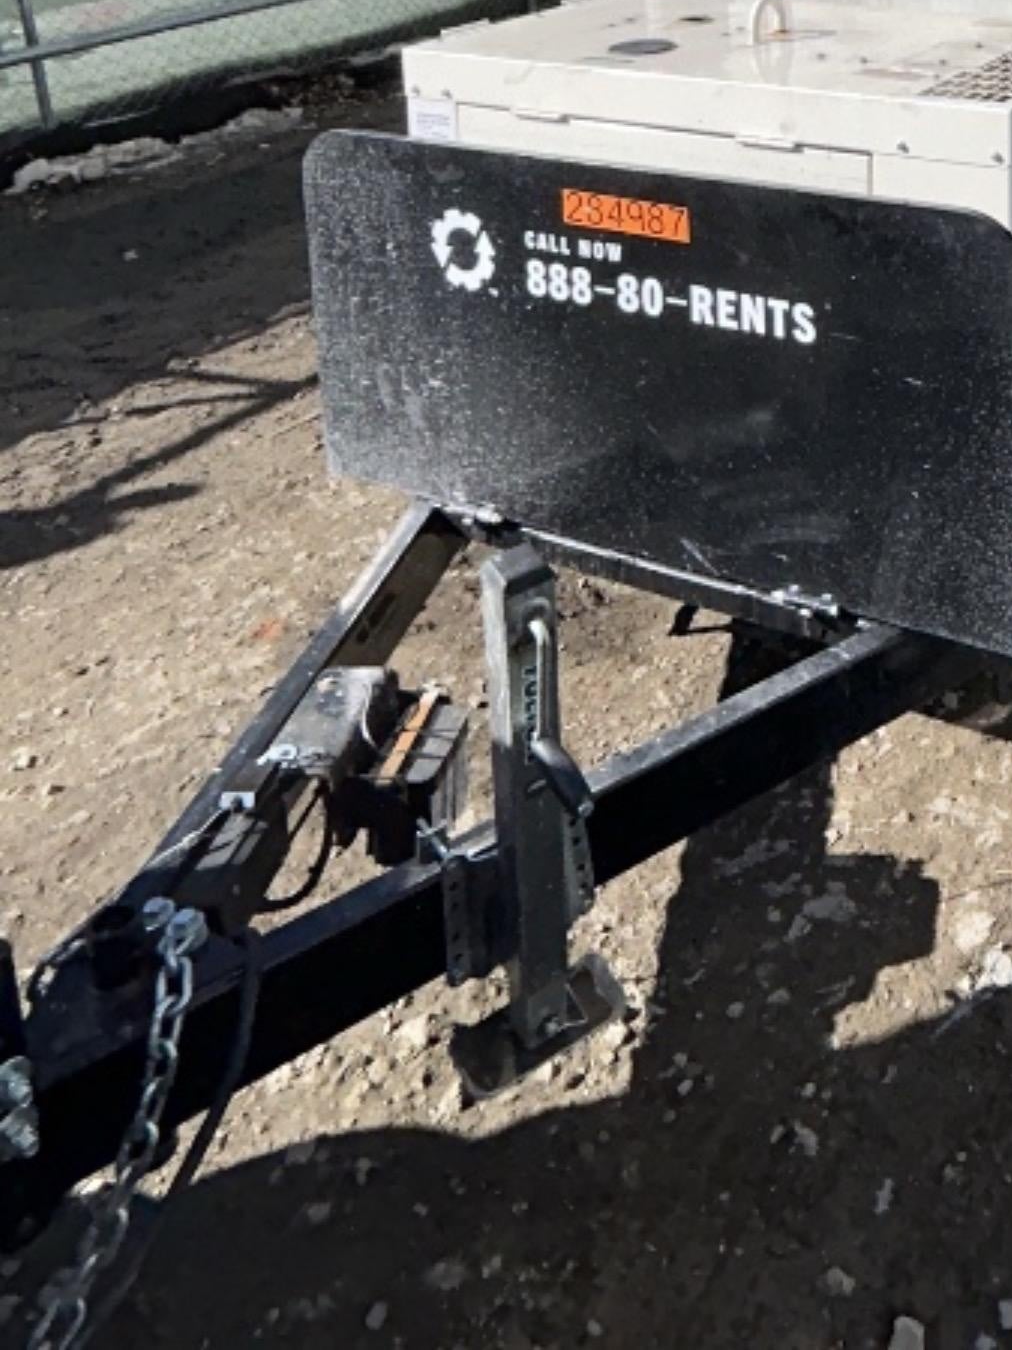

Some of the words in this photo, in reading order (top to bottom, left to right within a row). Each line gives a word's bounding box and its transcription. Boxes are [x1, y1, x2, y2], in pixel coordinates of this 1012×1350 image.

[565, 191, 685, 237] 284987
[523, 230, 571, 256] CALL
[577, 238, 623, 262] NOW
[526, 258, 817, 344] 888-80-RENTS
